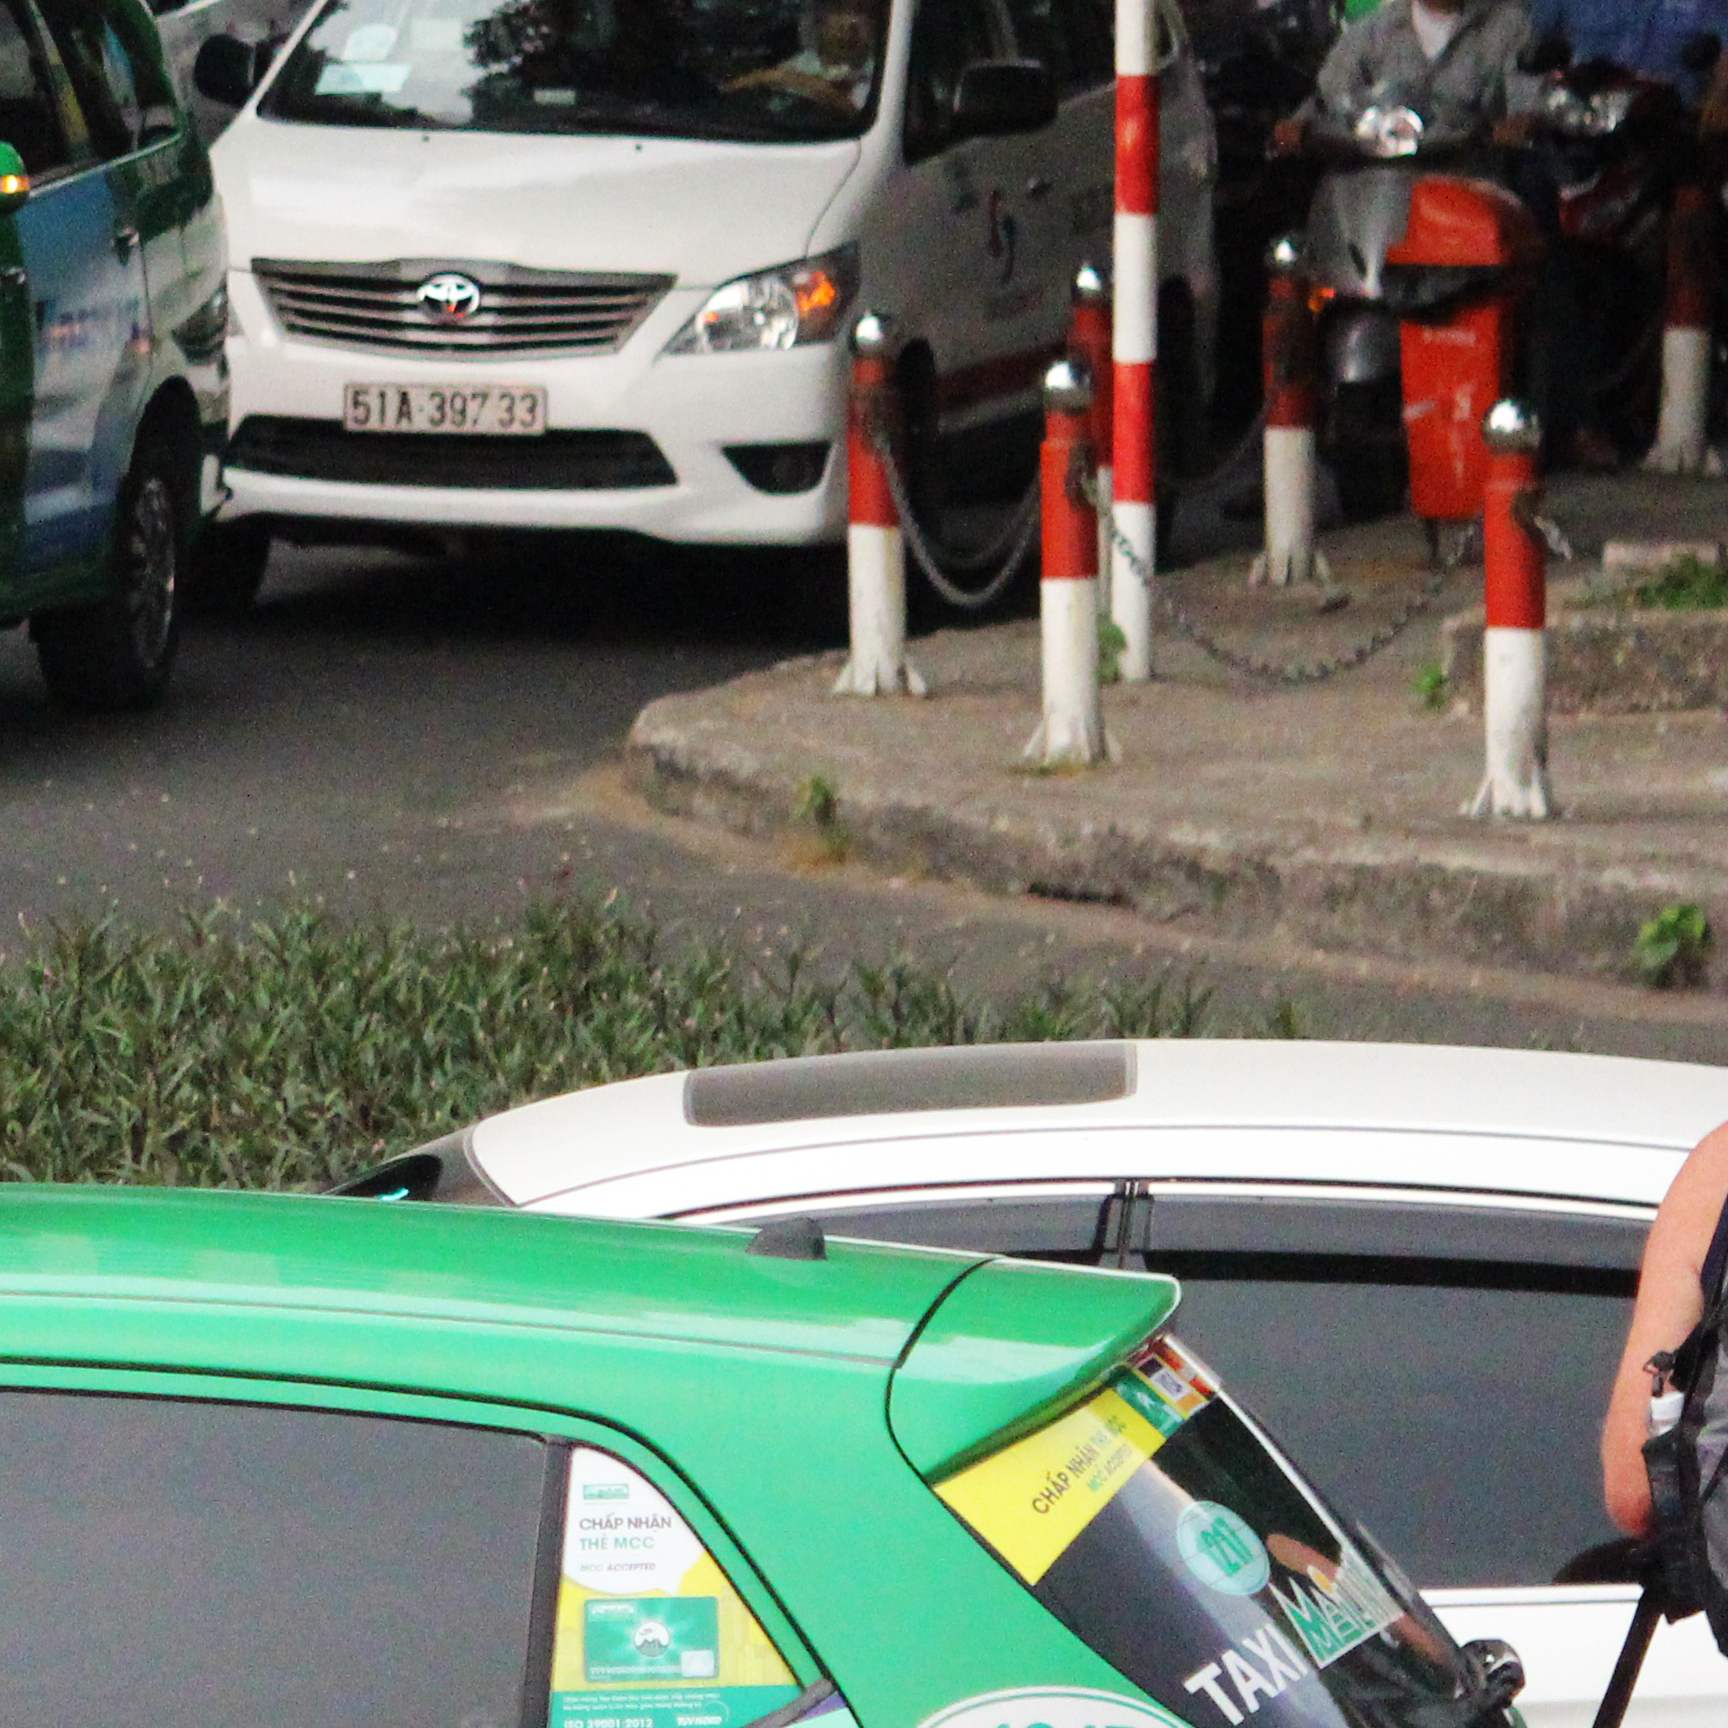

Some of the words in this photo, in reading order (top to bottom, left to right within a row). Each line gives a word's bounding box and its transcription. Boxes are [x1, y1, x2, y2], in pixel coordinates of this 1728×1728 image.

[1031, 1470, 1071, 1514] CHẤP
[579, 1513, 624, 1530] CHẤP
[627, 1514, 672, 1533] NHẬN
[580, 1533, 608, 1550] THẺ
[613, 1537, 655, 1550] MCC
[1182, 1623, 1308, 1726] TAXI
